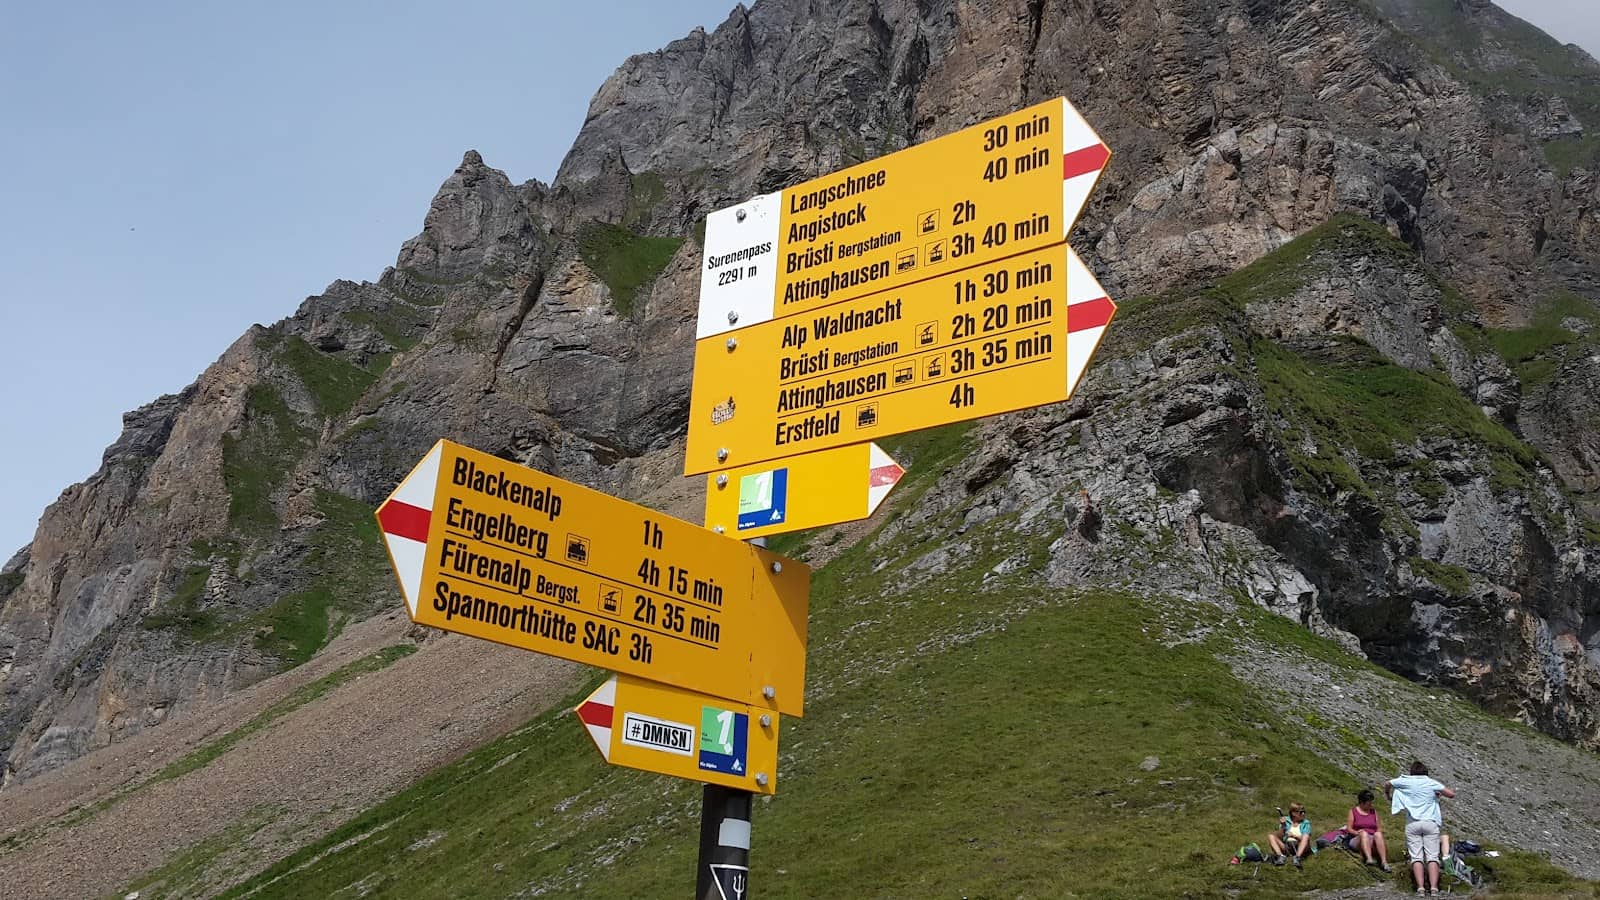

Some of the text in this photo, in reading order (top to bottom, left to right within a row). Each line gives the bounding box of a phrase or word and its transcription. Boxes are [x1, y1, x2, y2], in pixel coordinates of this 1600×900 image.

[788, 147, 1049, 244] Angistock 40 min
[790, 115, 1049, 215] Langschnee 30 min
[707, 241, 772, 270] Surenenpass
[717, 264, 758, 287] 2291 m
[783, 214, 1049, 305] Attinghausen 3h 40 min
[786, 199, 976, 274] Brüsti Bergstation 2h
[780, 297, 1052, 380] Brüsti Bergstation 2h 20 min
[781, 262, 1052, 353] Alp Waldnacht 1h 30 min
[775, 382, 974, 446] Erstfeld 4h
[777, 332, 1052, 413] Attinghausen 3h 35 min
[452, 456, 663, 550] Blackenalp 1h
[439, 537, 720, 644] Fürenalp Bergst. 2h 35 min
[446, 497, 723, 607] Engelberg 4h 15 min
[433, 581, 653, 665] Spannorthütte SAC 3h
[631, 722, 687, 748] #DMNSN
